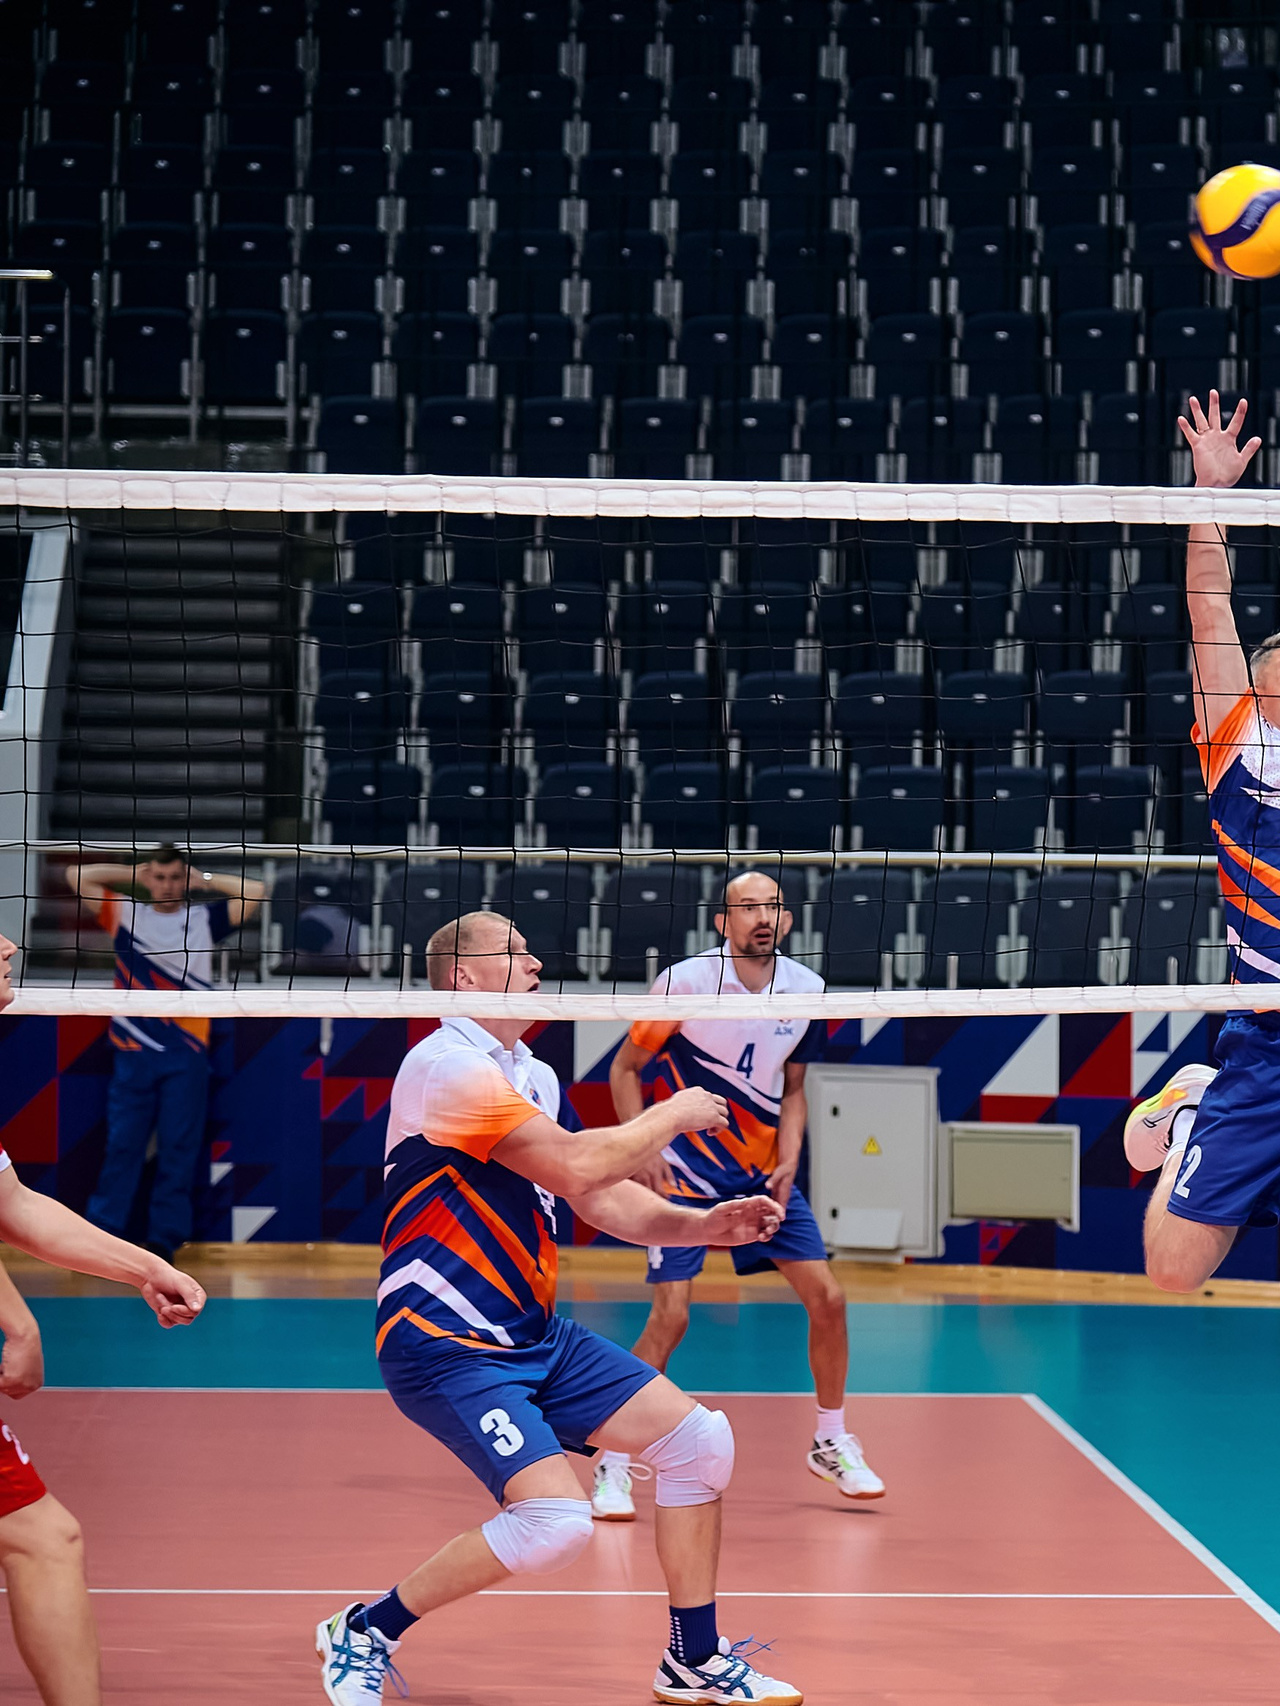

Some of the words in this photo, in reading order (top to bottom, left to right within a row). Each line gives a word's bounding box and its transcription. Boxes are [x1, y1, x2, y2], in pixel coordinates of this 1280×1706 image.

[735, 1042, 755, 1079] 4
[1174, 1144, 1203, 1199] 2
[479, 1407, 525, 1457] 3
